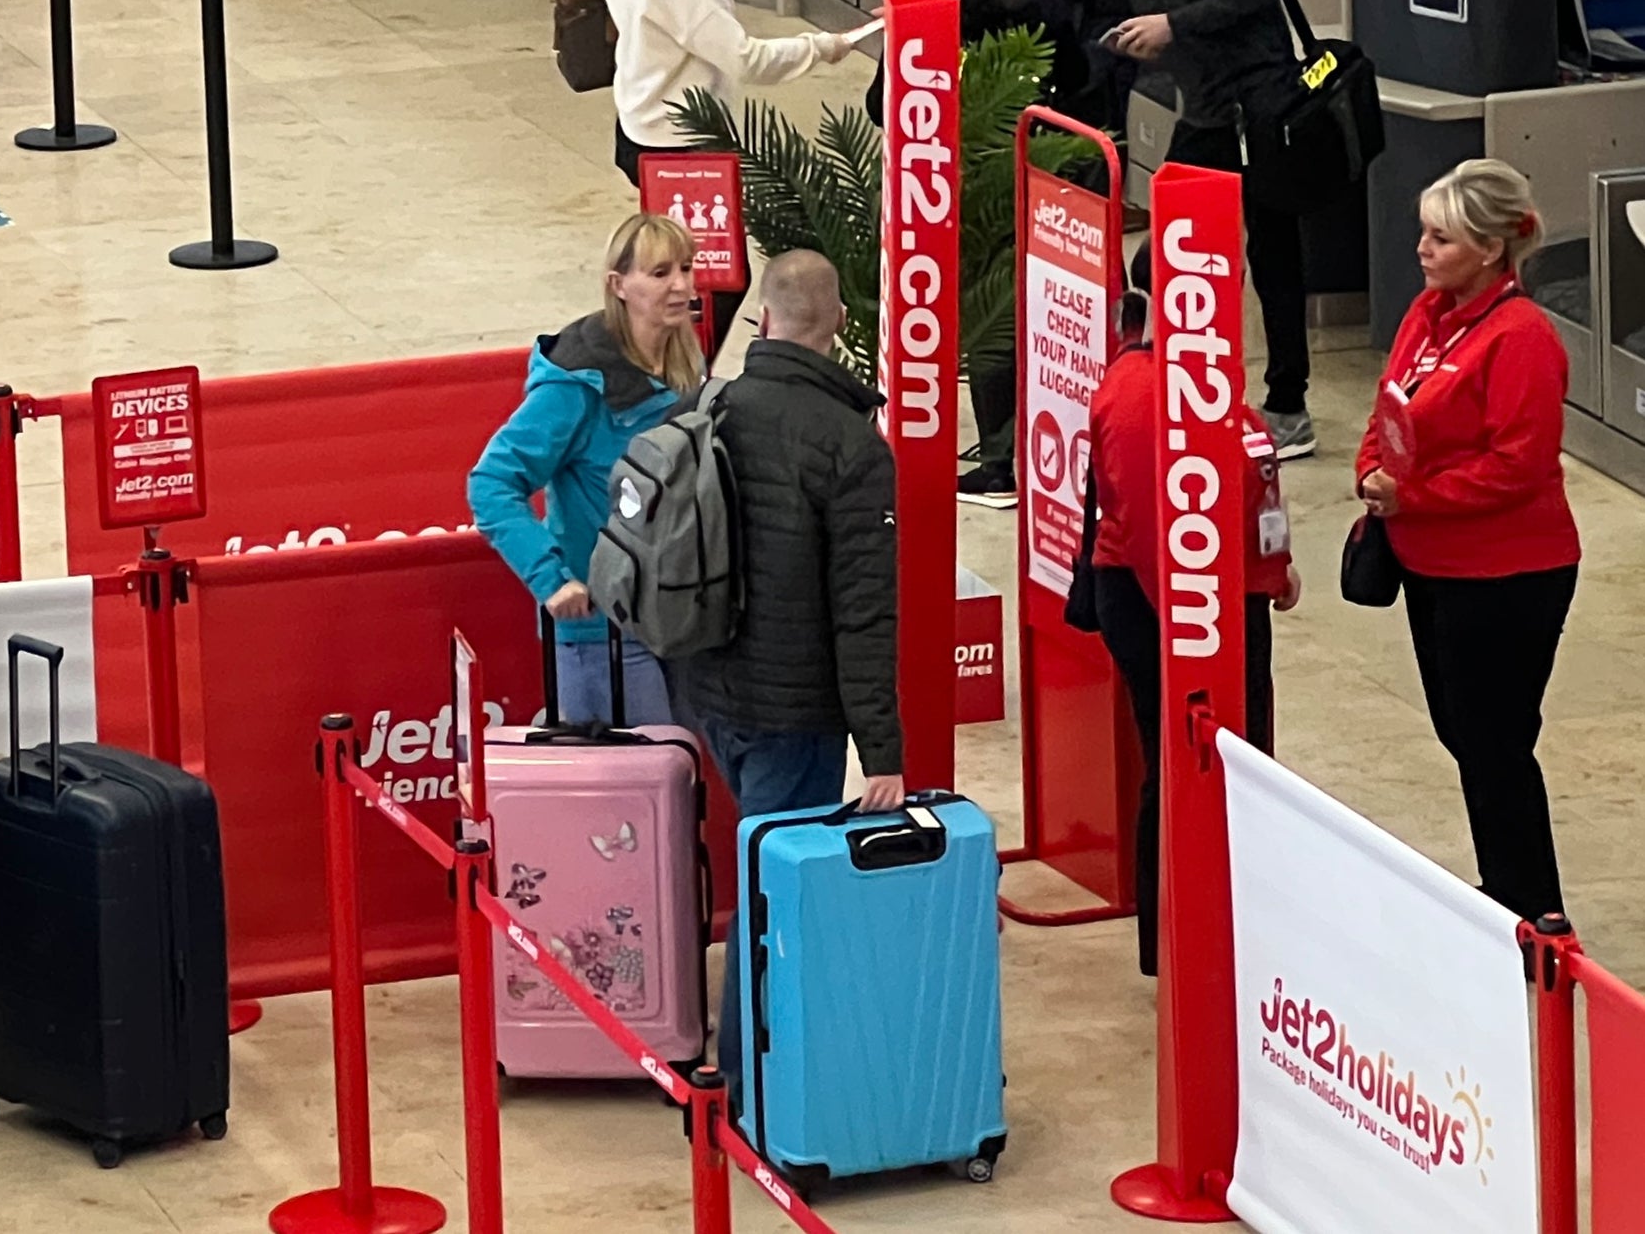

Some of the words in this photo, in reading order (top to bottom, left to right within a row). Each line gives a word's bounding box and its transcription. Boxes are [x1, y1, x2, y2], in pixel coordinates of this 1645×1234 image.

[898, 36, 954, 441] Jet2.com
[1033, 198, 1104, 251] Jet2.com
[1033, 222, 1066, 255] Friendly
[1065, 236, 1081, 258] low
[1081, 241, 1103, 268] fares
[693, 249, 732, 263] .com
[1043, 277, 1094, 320] PLEASE
[1046, 308, 1091, 350] CHECK
[1033, 331, 1067, 364] YOUR
[1070, 349, 1106, 384] HAND
[110, 388, 148, 402] LITHIUM
[149, 382, 189, 397] BATTERY
[111, 393, 189, 419] DEVICES
[1161, 216, 1234, 659] Jet2.com
[115, 472, 194, 493] Jet2.com
[957, 663, 993, 678] fares
[1260, 976, 1468, 1168] Jet2holidays
[1260, 1035, 1307, 1087] Package
[1307, 1070, 1355, 1121] holidays
[1356, 1107, 1378, 1137] you
[1378, 1125, 1401, 1153] can
[1402, 1136, 1432, 1177] trust
